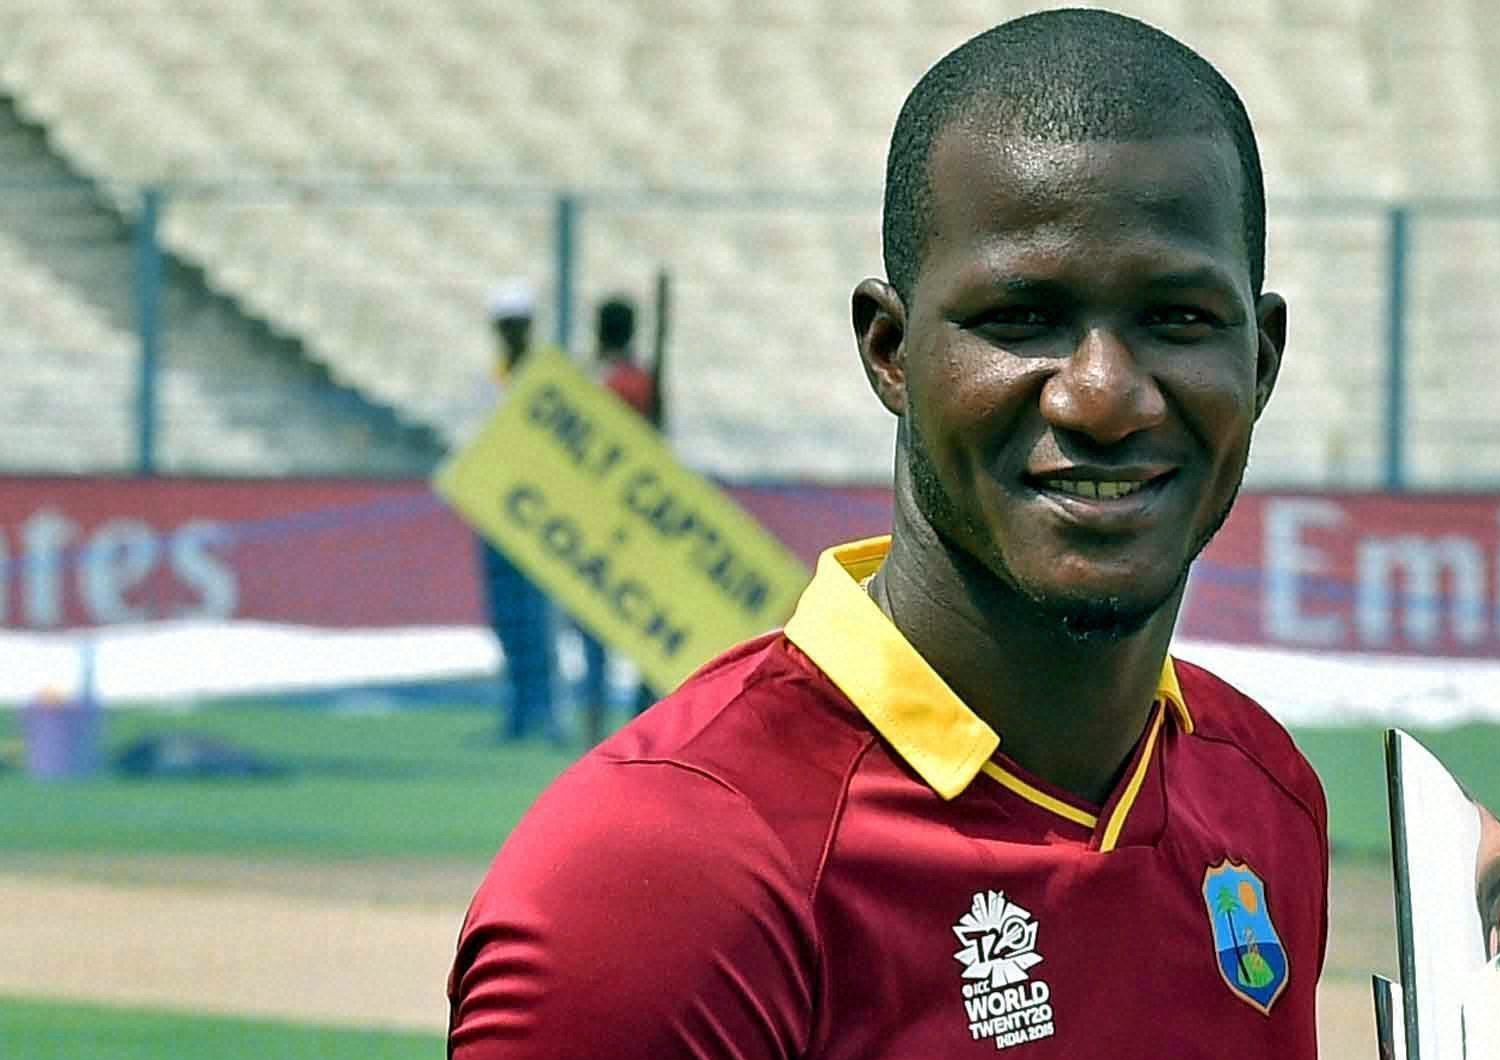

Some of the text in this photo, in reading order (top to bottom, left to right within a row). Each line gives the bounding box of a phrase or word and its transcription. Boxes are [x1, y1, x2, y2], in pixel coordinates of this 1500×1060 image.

[0, 505, 241, 624] tes
[505, 483, 688, 657] COACH
[964, 980, 1050, 1022] WORLD
[968, 1003, 1053, 1040] TWENTY20
[996, 1030, 1029, 1049] INDIA
